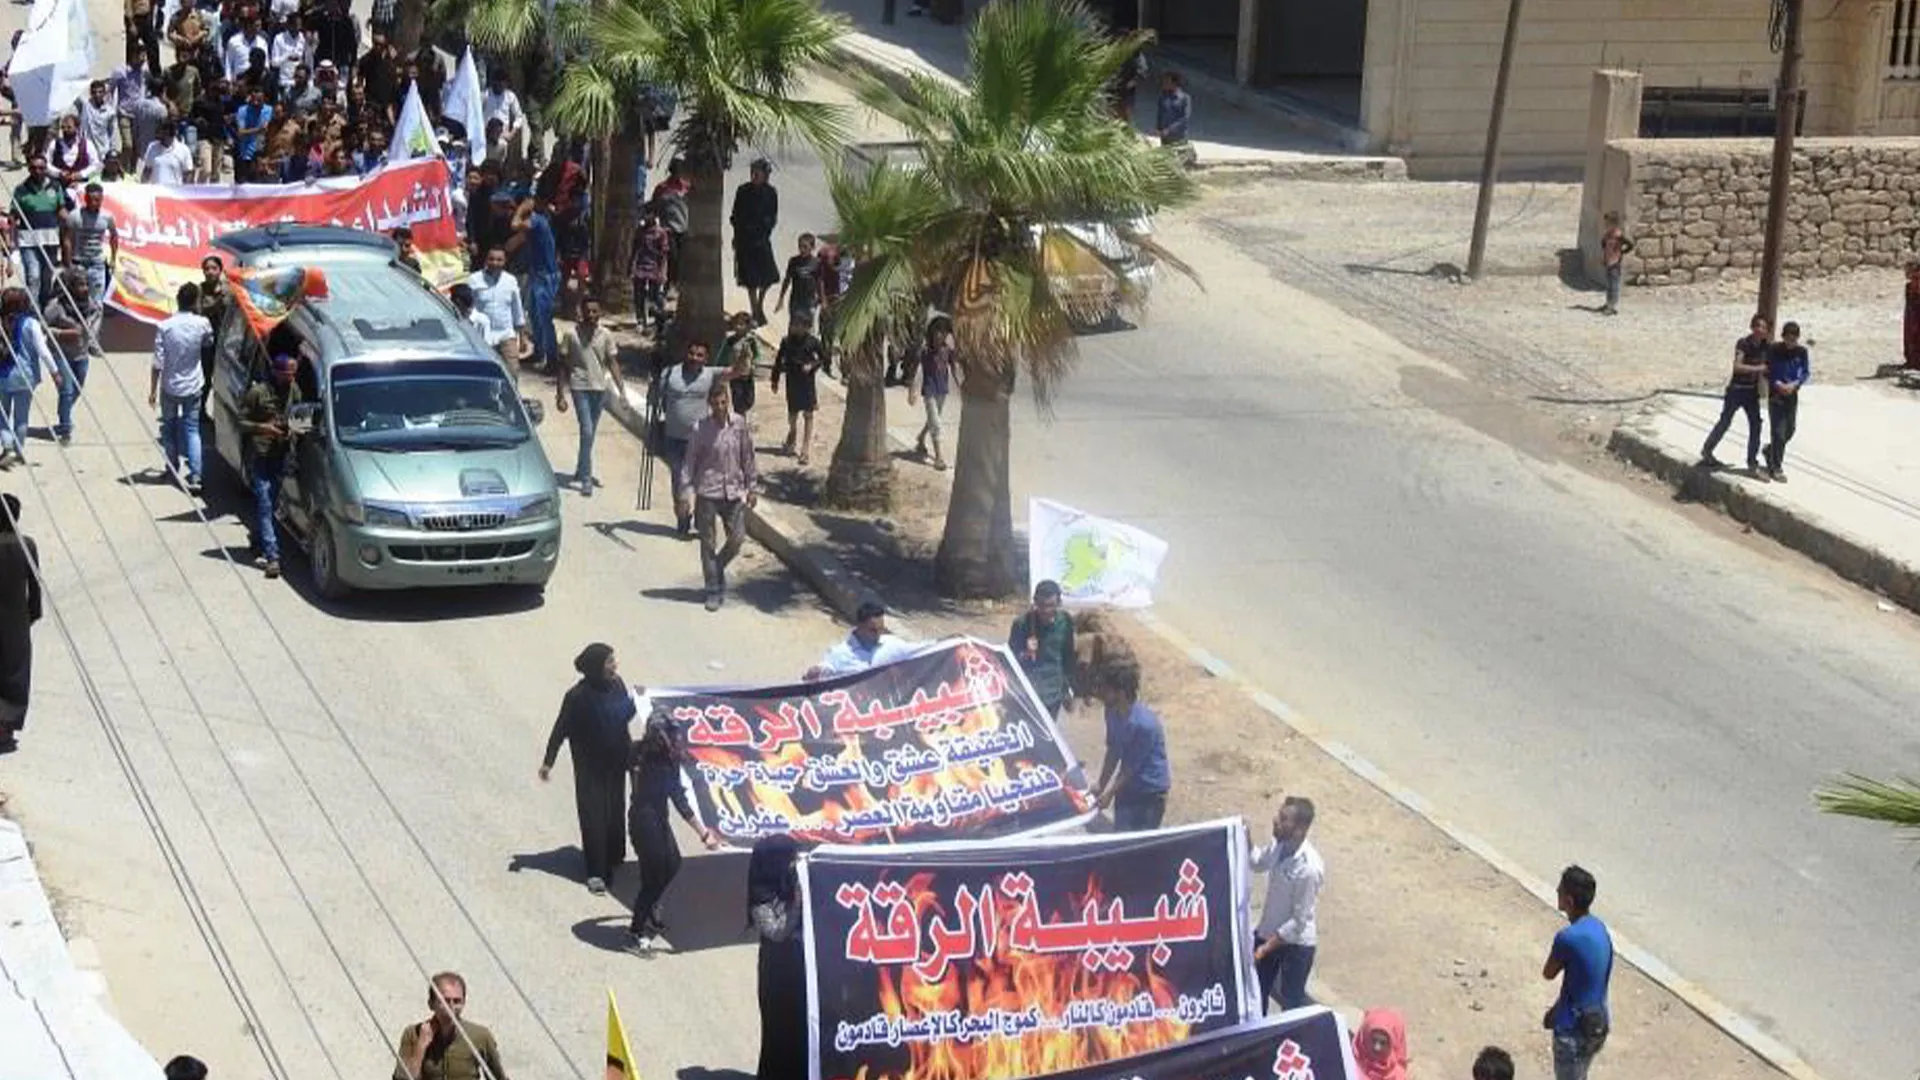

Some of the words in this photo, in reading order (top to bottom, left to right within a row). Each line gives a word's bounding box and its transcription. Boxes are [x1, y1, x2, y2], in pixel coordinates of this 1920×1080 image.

[820, 655, 1003, 740] شبيبة
[673, 700, 822, 752] الرقة
[938, 720, 1034, 767] الحقيقة
[696, 761, 746, 789] حرة
[744, 760, 803, 792] حياة
[804, 754, 887, 791] والعشق
[884, 743, 943, 784] عشق
[717, 804, 792, 838] عفرين
[836, 801, 905, 836] العصر
[902, 784, 986, 826] مقاومة
[836, 880, 998, 982] الرقة
[1000, 858, 1210, 971] شبيبة
[1001, 1005, 1040, 1037] كموج
[1061, 998, 1107, 1031] كالنار
[1106, 992, 1156, 1028] قادمون
[1178, 983, 1226, 1023] ثائرون
[834, 1014, 889, 1051] قادمون
[958, 1008, 1001, 1043] البحر
